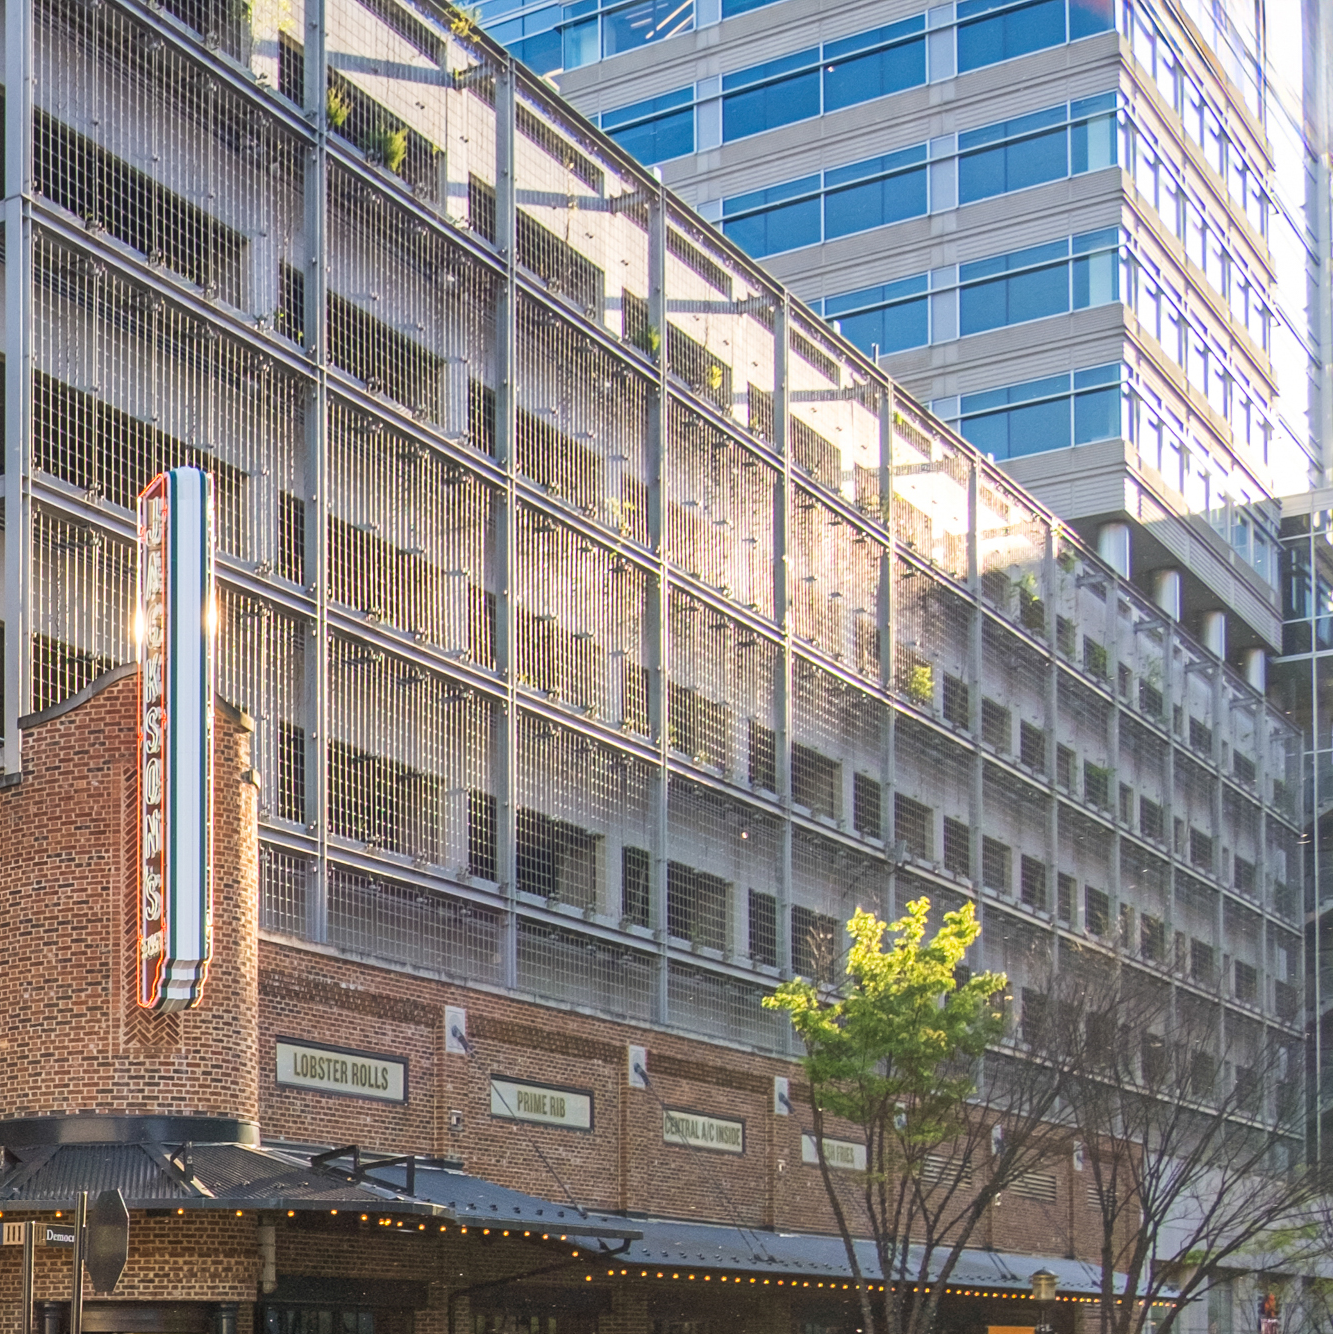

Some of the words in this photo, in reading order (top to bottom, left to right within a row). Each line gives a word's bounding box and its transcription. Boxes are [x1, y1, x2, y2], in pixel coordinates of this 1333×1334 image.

[293, 1052, 348, 1084] LOBSTER
[351, 1062, 389, 1091] ROLLS
[516, 1090, 547, 1115] PRIME
[549, 1097, 566, 1118] RIB
[664, 1115, 700, 1140] CENTRAL
[701, 1121, 715, 1143] A/C
[715, 1123, 741, 1147] INSIDE
